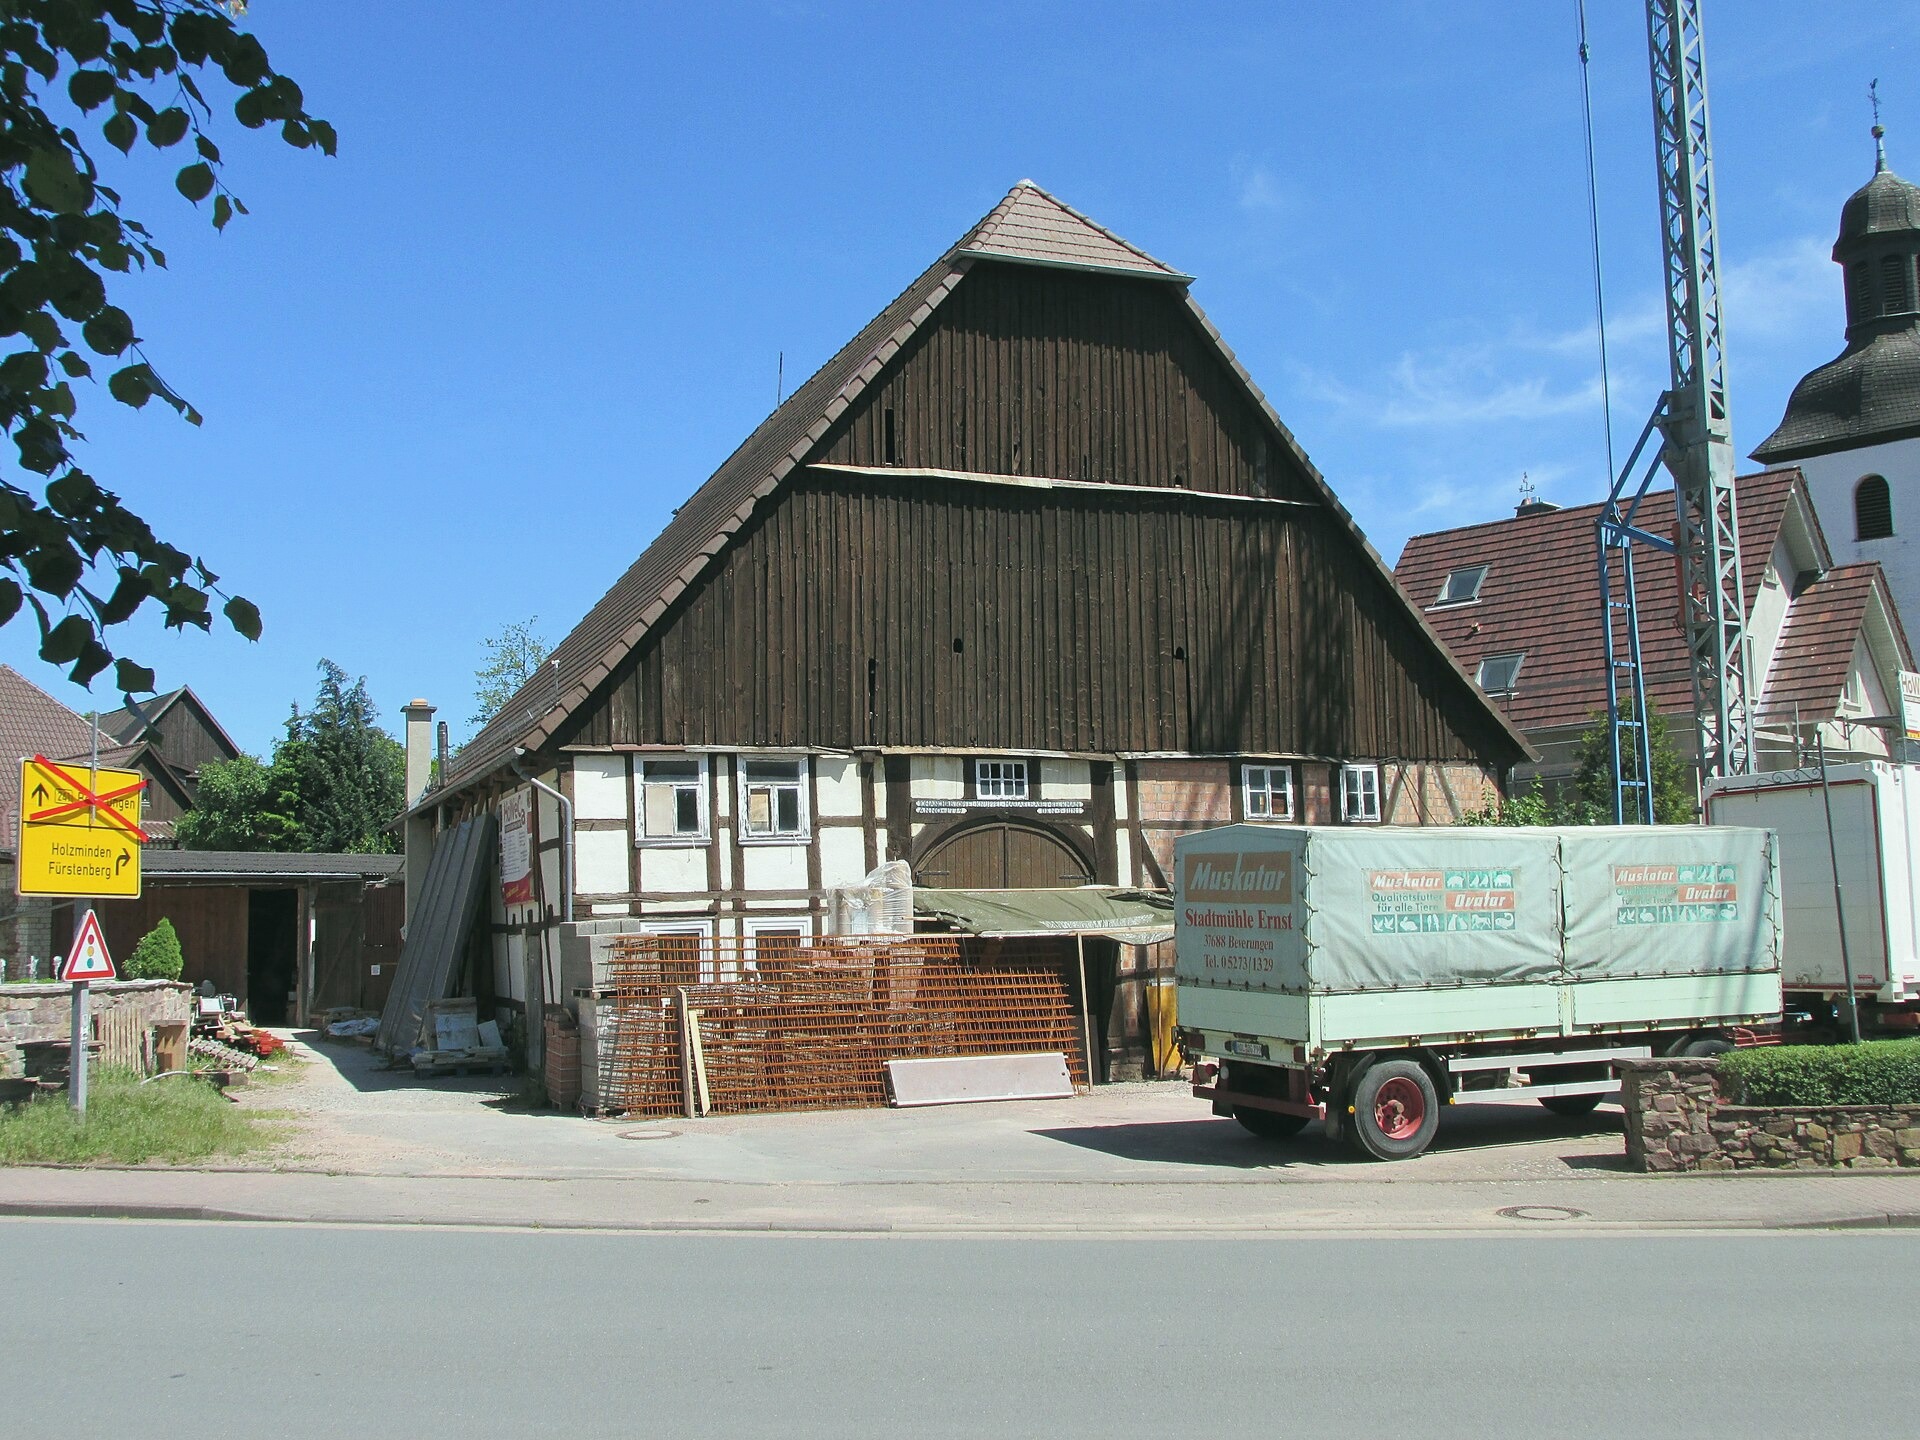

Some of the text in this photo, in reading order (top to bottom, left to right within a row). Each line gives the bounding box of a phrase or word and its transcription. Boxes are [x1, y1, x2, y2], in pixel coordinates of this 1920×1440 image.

[51, 842, 112, 858] Holzminden
[48, 861, 111, 880] Fürstenberg
[1189, 852, 1286, 891] Muskator
[1616, 866, 1675, 882] Muskator
[1372, 872, 1441, 887] Muskator
[1377, 902, 1392, 912] für
[1395, 902, 1412, 912] alle
[1185, 907, 1293, 930] Stadtmühle Ernst
[1203, 934, 1274, 953] 37688 Beverungen
[1203, 953, 1219, 968] Tel.
